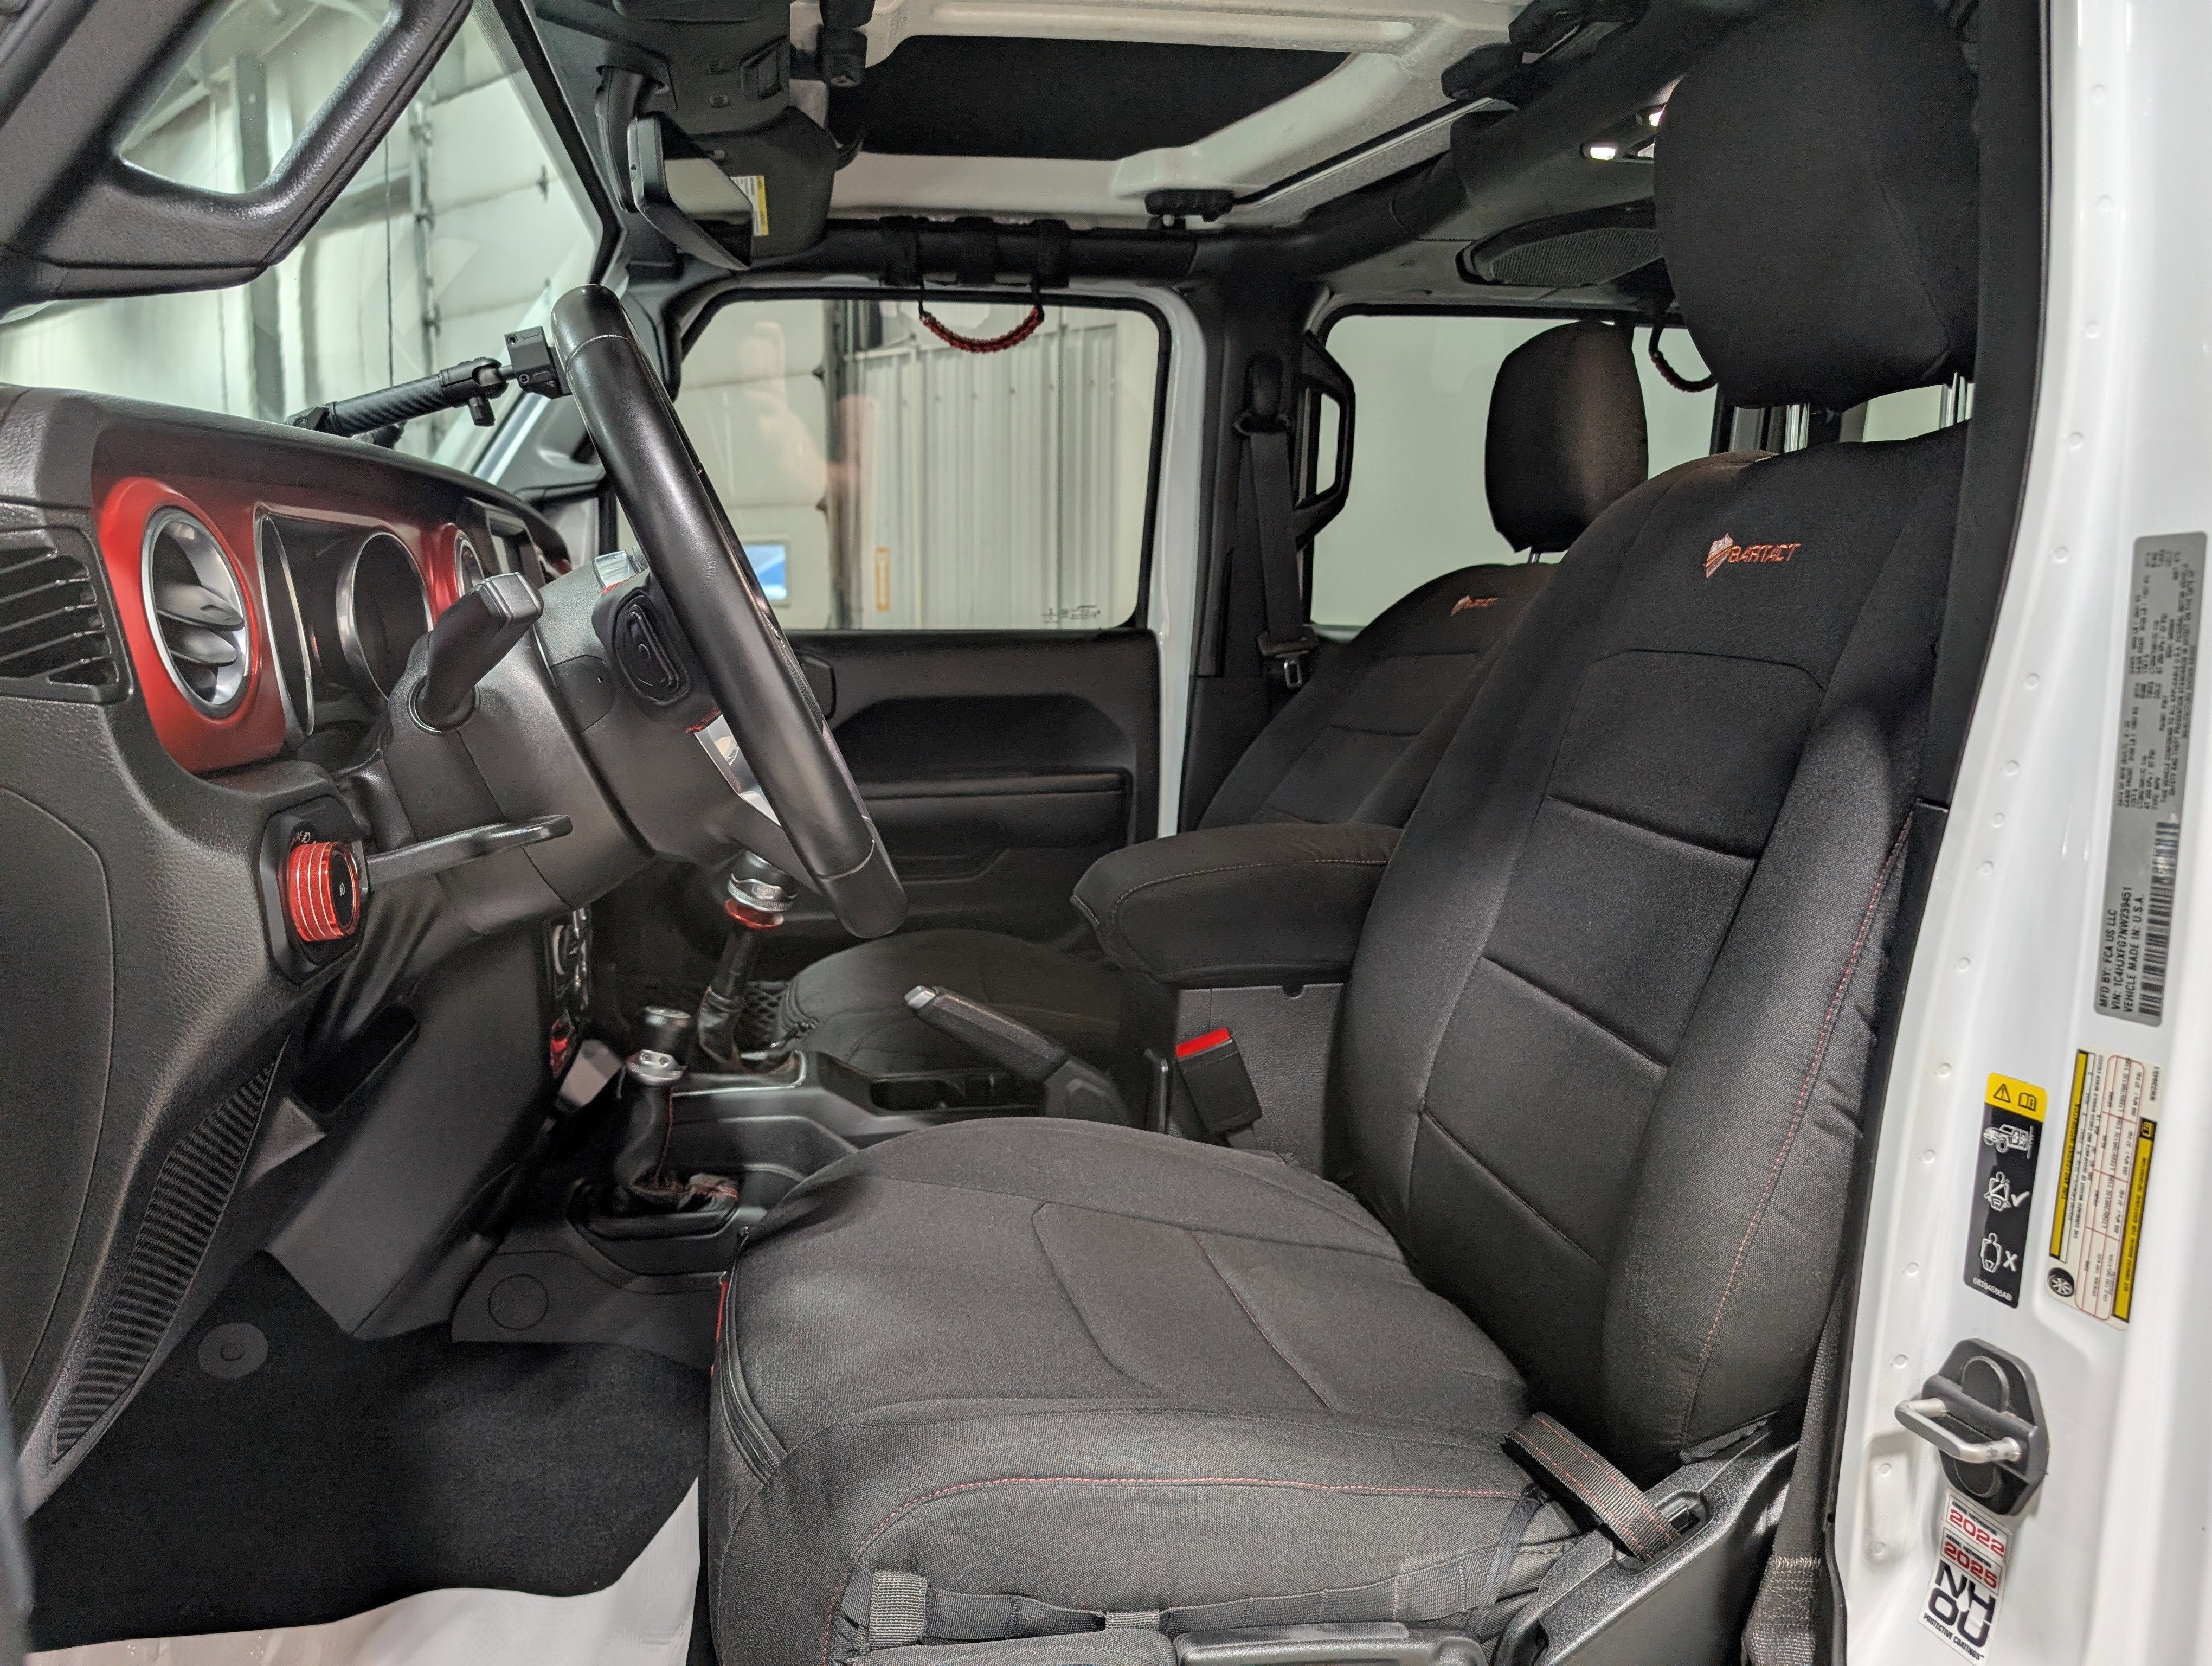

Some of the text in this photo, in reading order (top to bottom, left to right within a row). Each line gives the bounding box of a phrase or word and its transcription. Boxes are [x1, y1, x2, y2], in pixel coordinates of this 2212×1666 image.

[1728, 543, 1801, 563] BARTACT
[2098, 908, 2117, 1007] MFD BY: FCA US LLC
[2127, 943, 2138, 971] MADE
[2111, 990, 2121, 1010] VIN:
[2124, 973, 2135, 1013] VEHICLE
[1949, 1508, 2005, 1559] 2022
[1943, 1541, 1998, 1589] 2025
[1923, 1612, 1954, 1640] PROTECTIVE
